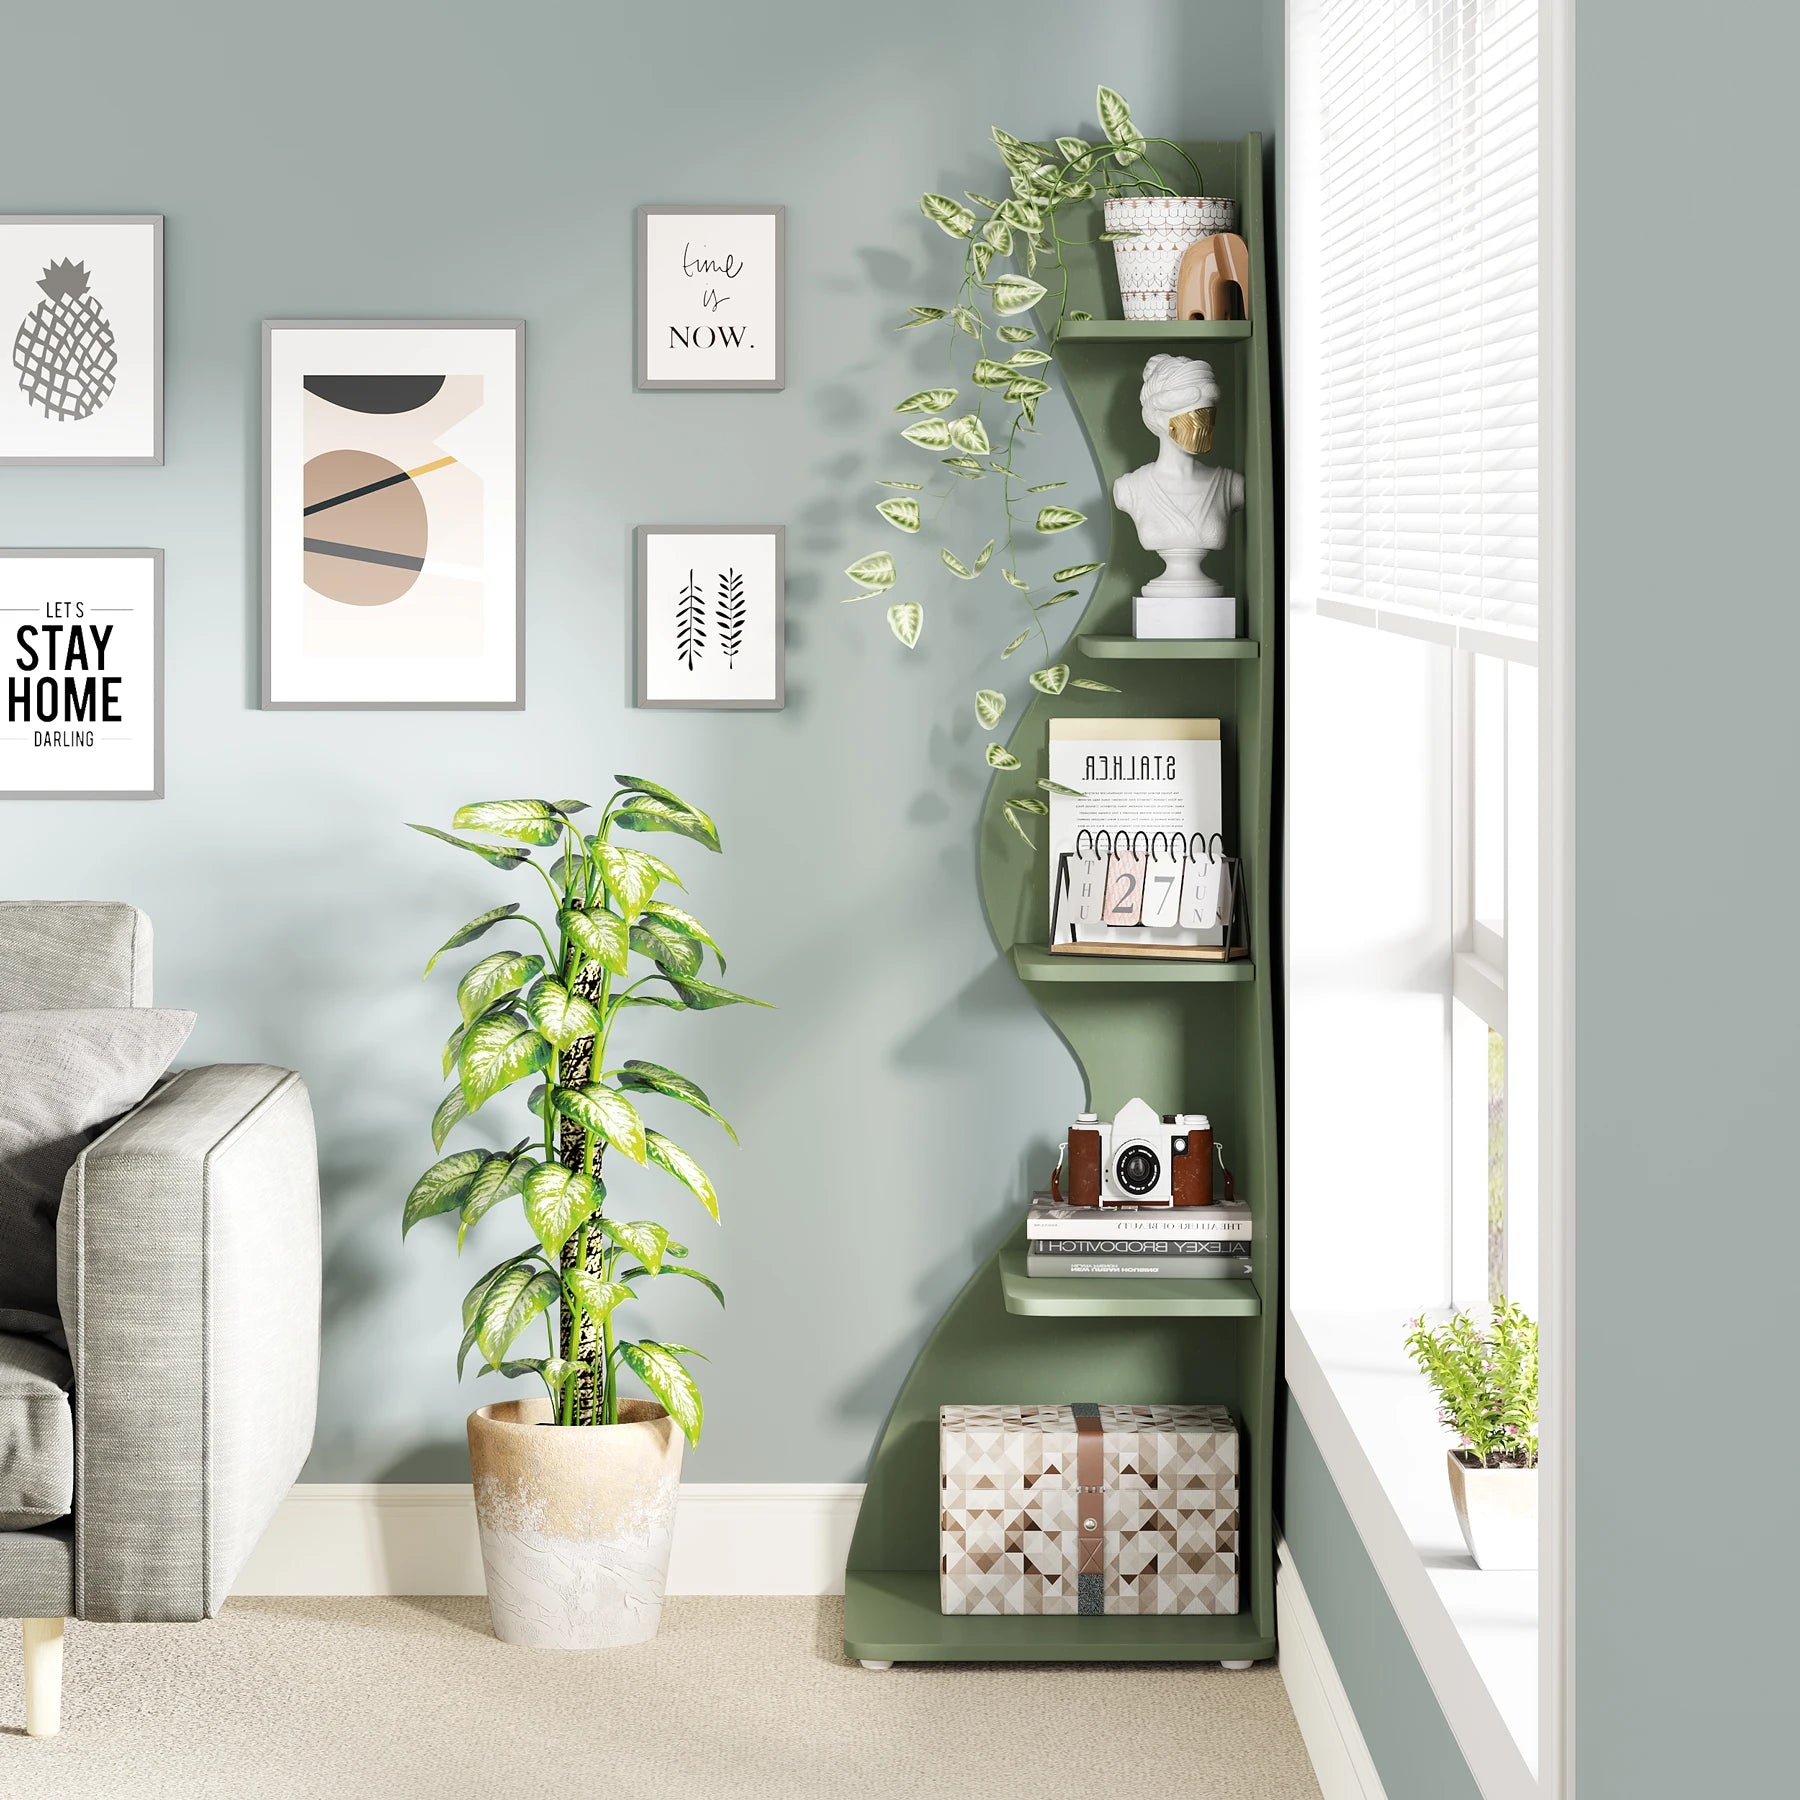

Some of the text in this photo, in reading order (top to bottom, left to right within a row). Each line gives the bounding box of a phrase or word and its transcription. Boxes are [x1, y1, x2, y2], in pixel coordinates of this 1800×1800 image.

[682, 242, 743, 278] time
[703, 282, 730, 312] is
[668, 325, 755, 349] NOW.
[16, 624, 114, 671] STAY
[8, 676, 122, 722] HOME
[34, 731, 94, 747] DARLING
[1079, 859, 1095, 920] THU
[1192, 862, 1208, 923] JUN
